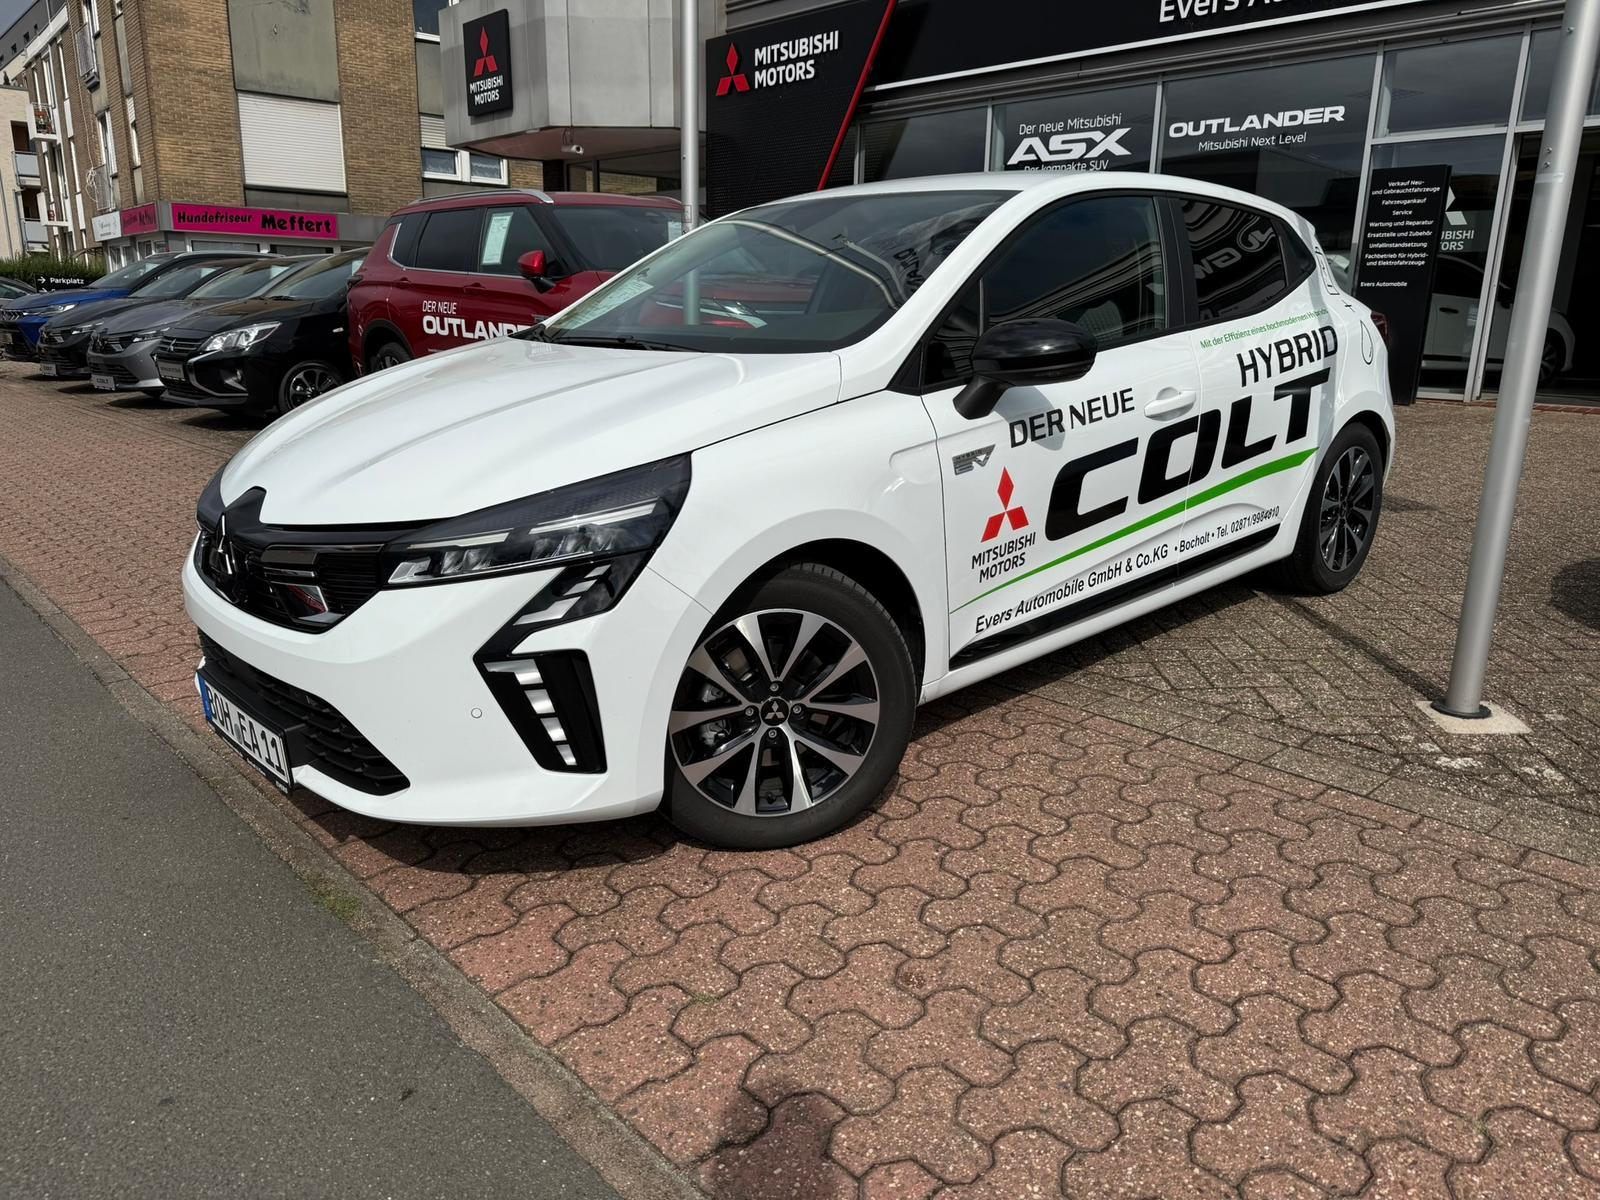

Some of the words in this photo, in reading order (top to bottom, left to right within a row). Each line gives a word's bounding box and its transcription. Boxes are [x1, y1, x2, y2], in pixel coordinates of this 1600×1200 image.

[754, 30, 839, 67] MITSUBISHI
[469, 75, 504, 94] MITSUBISHI
[754, 59, 815, 89] MOTORS
[474, 89, 500, 106] MOTORS
[1019, 124, 1036, 135] Der
[1039, 121, 1064, 133] neue
[1067, 113, 1122, 130] Mitsubishi
[1169, 106, 1345, 138] OUTLANDER
[1006, 127, 1132, 165] ASX
[1199, 137, 1248, 151] Mitsubishi
[1251, 134, 1276, 147] Next
[1279, 132, 1307, 144] Level
[1089, 159, 1109, 171] SUV
[1382, 197, 1427, 206] Fahrzeugankauf
[1383, 187, 1440, 195] Gebrauchtfahrzeuge
[177, 211, 253, 224] Hundefriseur
[261, 214, 331, 233] Meffert
[1369, 241, 1428, 249] Unfallinstandsetzung
[50, 277, 84, 285] Parkplatz
[422, 300, 436, 313] DER
[438, 301, 457, 314] NEUE
[1200, 340, 1212, 349] Mit
[1213, 337, 1224, 345] der
[1224, 329, 1250, 343] Effizienz
[1251, 325, 1267, 335] eines
[1267, 314, 1308, 331] hochmodernen
[1237, 325, 1337, 387] HYBRID
[1010, 409, 1066, 448] DER
[1069, 388, 1135, 430] NEUE
[1045, 366, 1331, 541] COLT
[972, 532, 1036, 569] MITSUBISHI
[976, 608, 1012, 633] Evers
[1015, 580, 1084, 617] Automobile
[1088, 562, 1122, 588] GmbH
[1125, 557, 1133, 573] &
[1136, 544, 1168, 568] Co.KG
[1217, 526, 1228, 539] Tel.
[1231, 505, 1279, 533] 02871/9984810
[980, 553, 1025, 583] MOTORS
[206, 685, 235, 736] BOH
